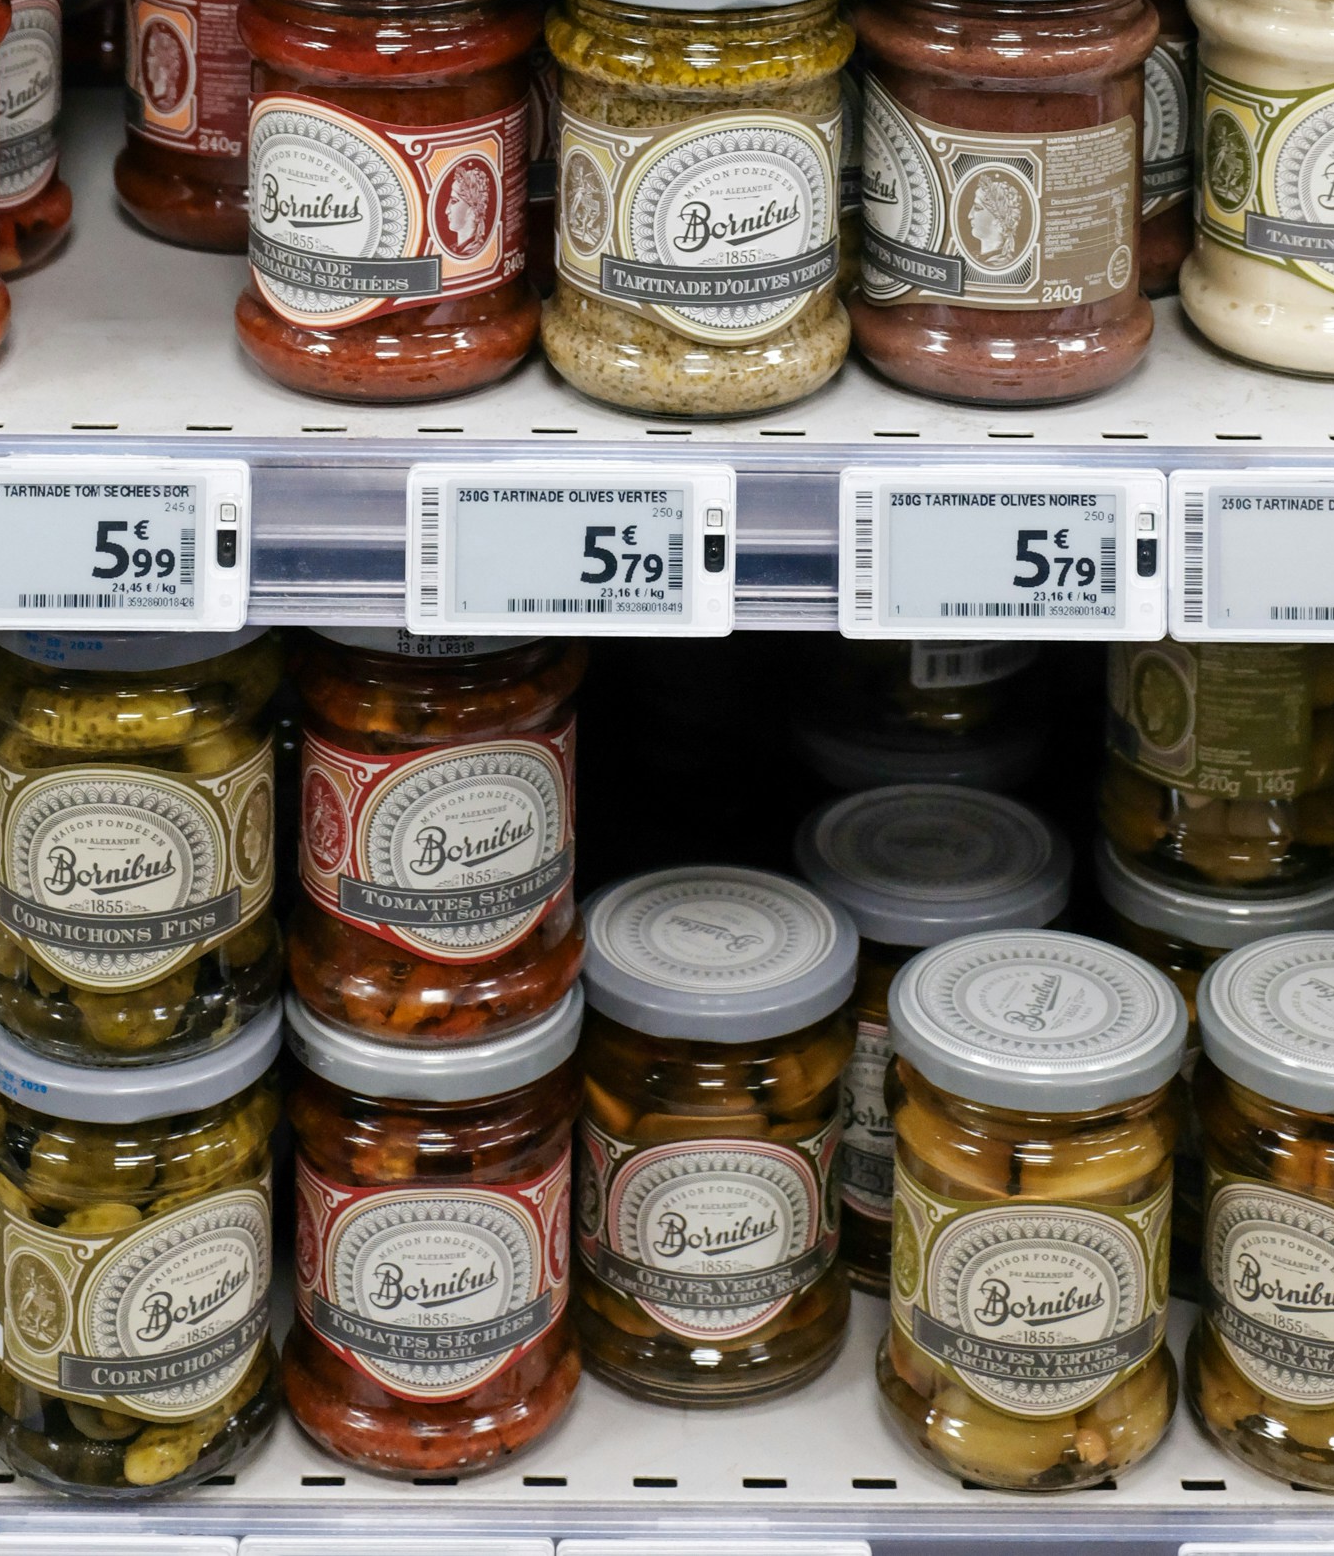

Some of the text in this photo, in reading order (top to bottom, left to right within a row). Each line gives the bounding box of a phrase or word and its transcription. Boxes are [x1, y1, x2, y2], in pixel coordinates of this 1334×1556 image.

[891, 494, 1096, 508] 250G TARTINADE OLIVES NOIRES
[44, 846, 177, 895] Bornibus
[11, 905, 217, 943] CORNICHONS FINS
[329, 1310, 533, 1349] TOMATES SÉCHÉES
[955, 1337, 1117, 1365] OLIVES VERTES
